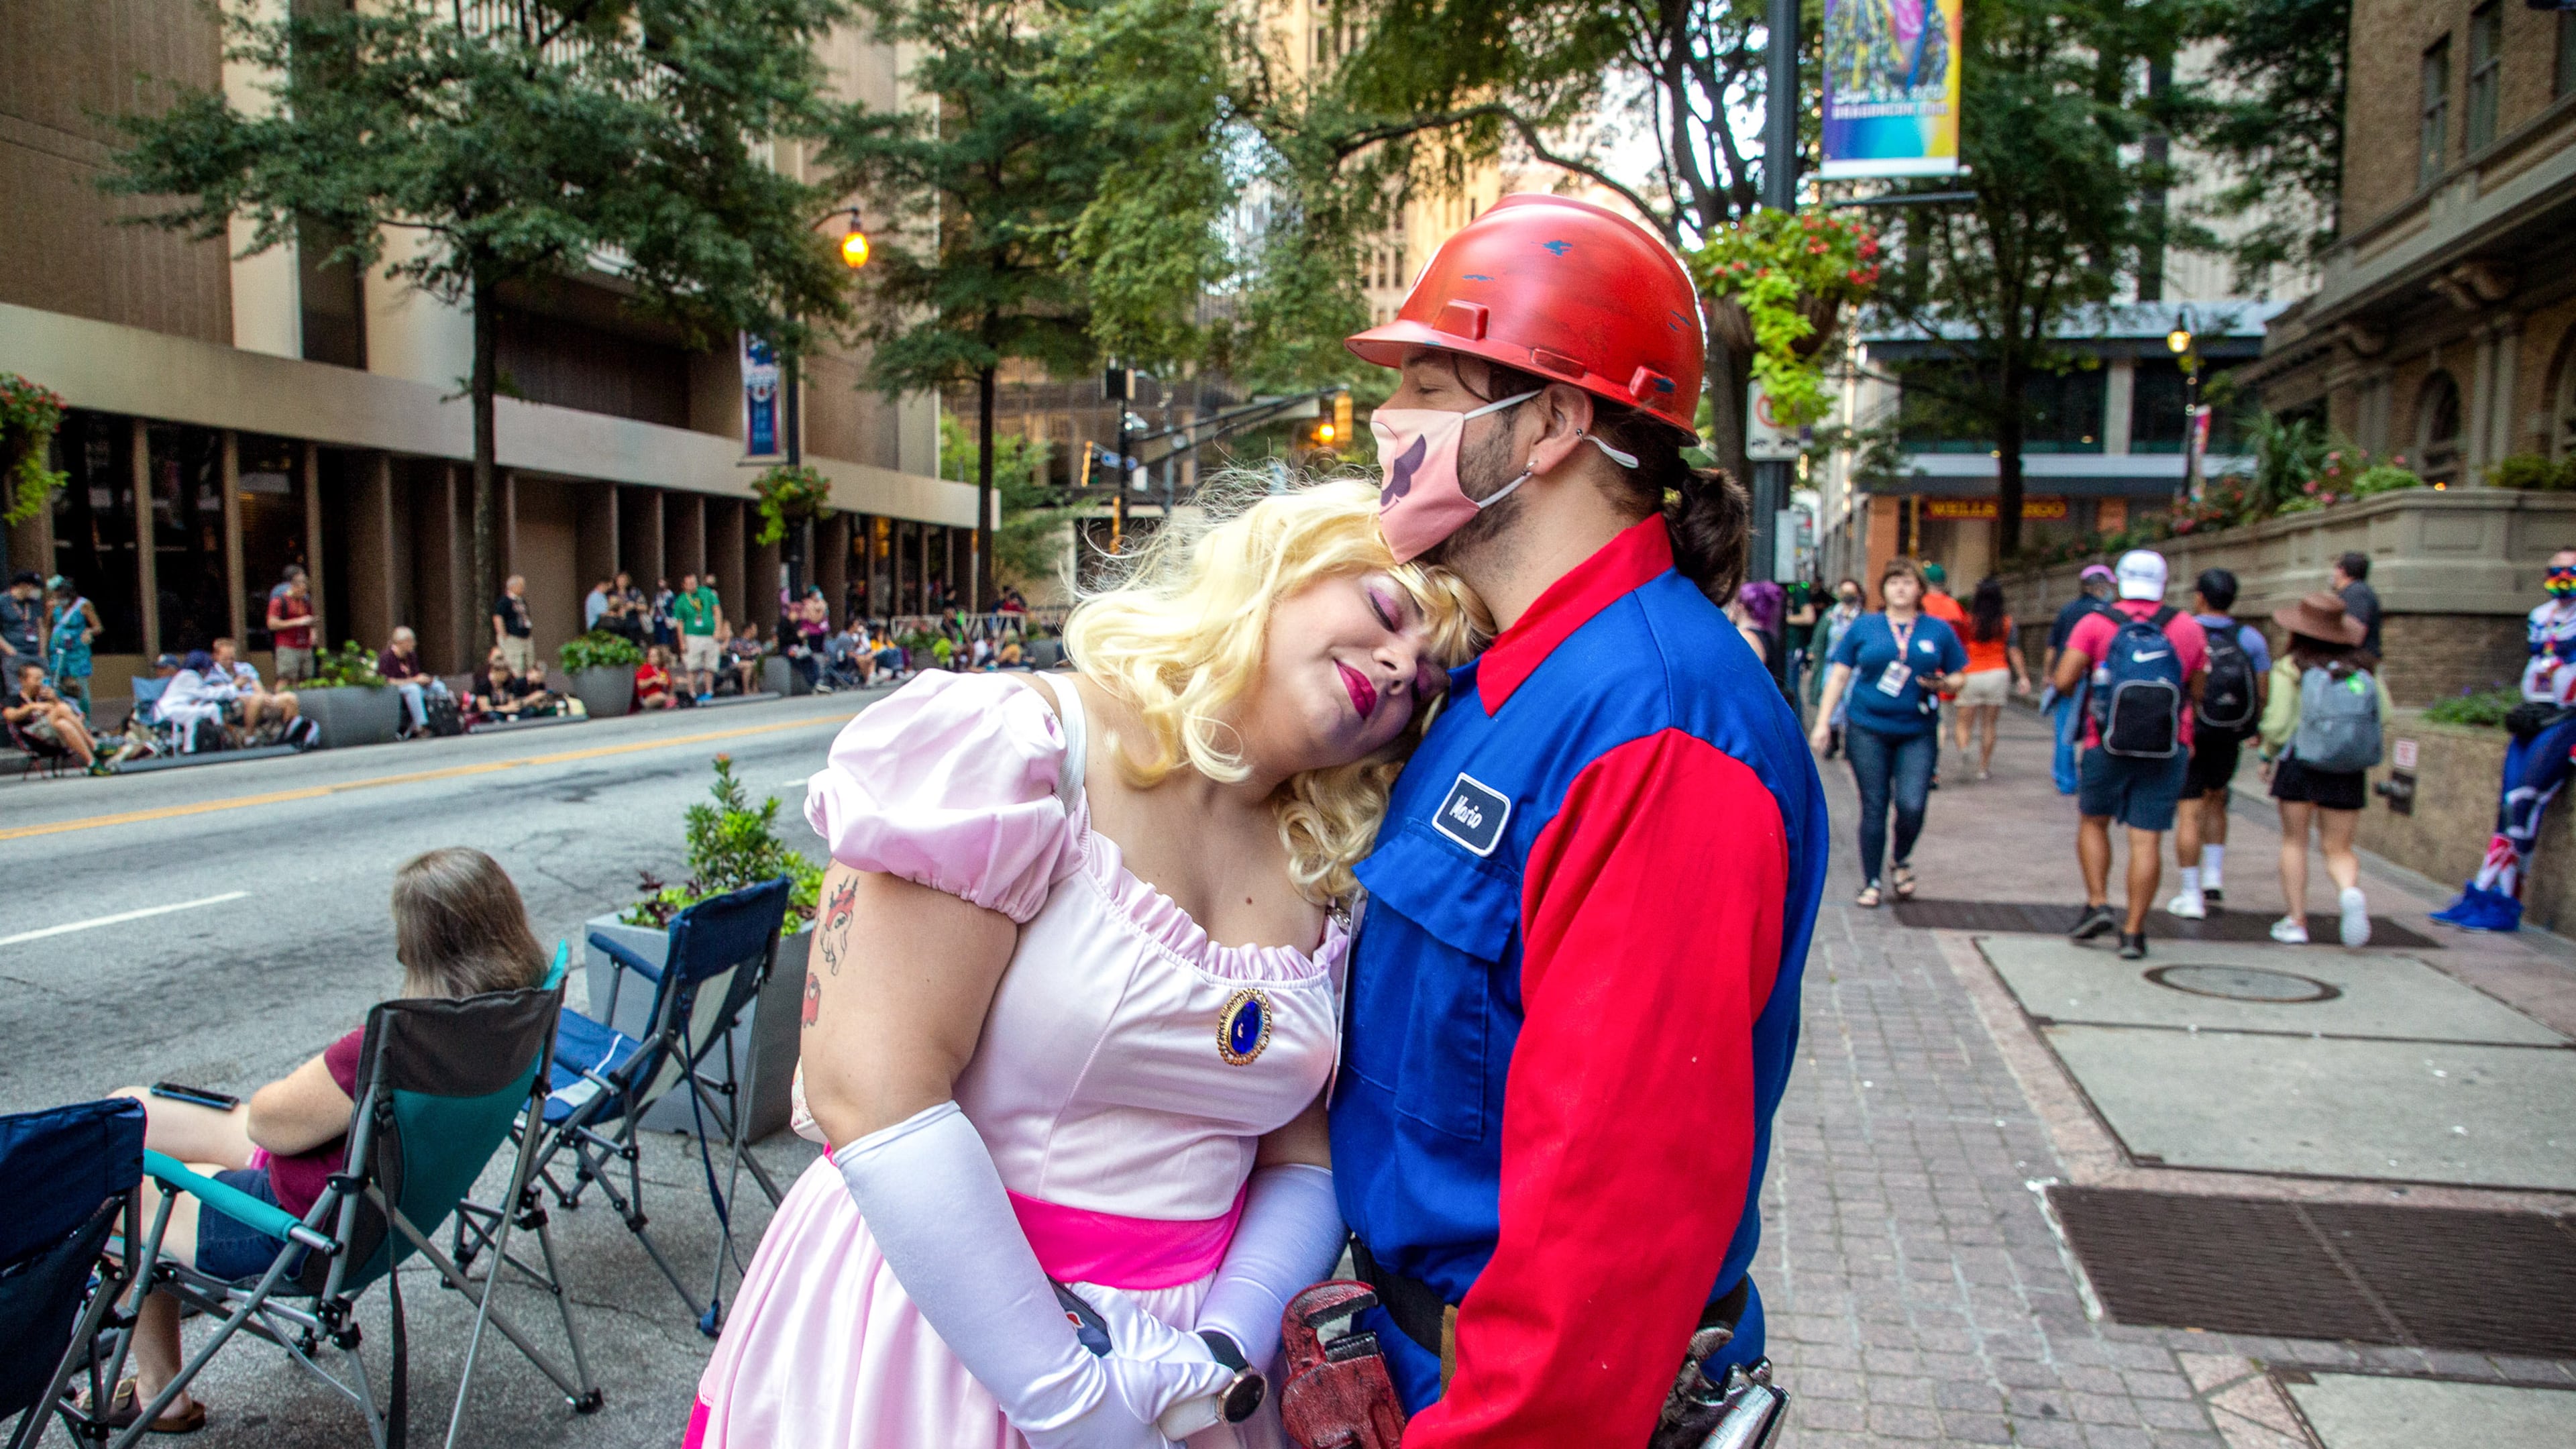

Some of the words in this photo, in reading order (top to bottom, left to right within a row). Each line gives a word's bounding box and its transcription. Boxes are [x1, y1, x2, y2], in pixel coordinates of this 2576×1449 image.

[1928, 500, 1998, 518] WELLS
[2021, 500, 2066, 518] RGO
[1449, 794, 1483, 829] Mario
